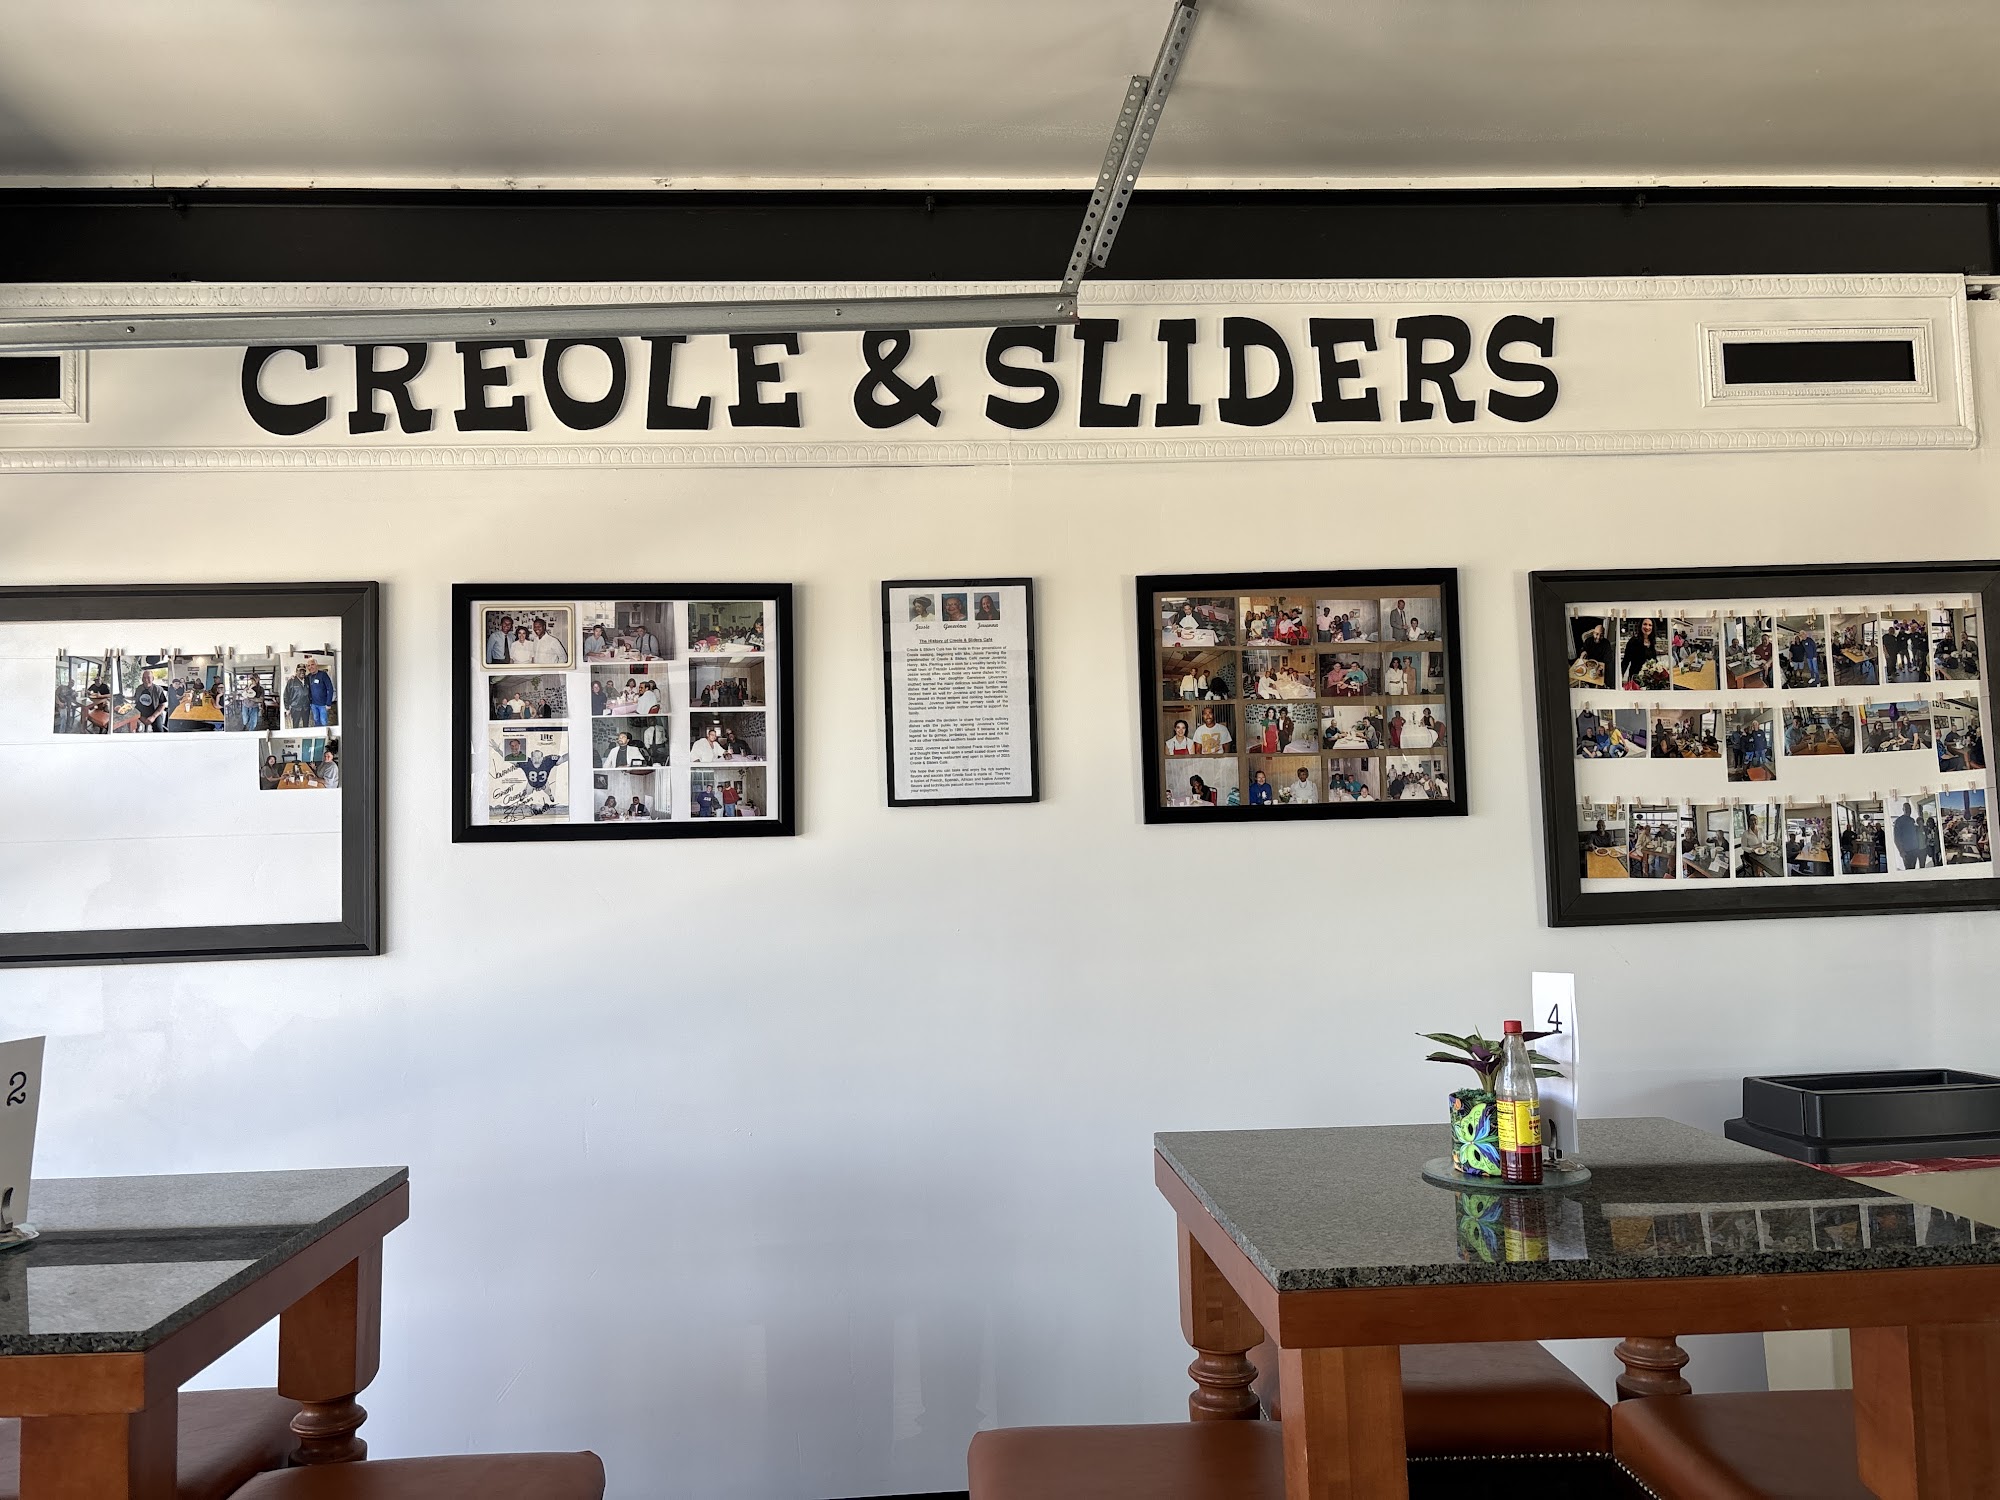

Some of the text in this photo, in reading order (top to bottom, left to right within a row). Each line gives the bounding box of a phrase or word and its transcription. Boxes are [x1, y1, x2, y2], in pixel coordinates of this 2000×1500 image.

[241, 315, 1559, 435] CREOLE & SLIDERS
[528, 770, 548, 783] 83
[1547, 1003, 1563, 1034] 4
[7, 1071, 27, 1107] 2
